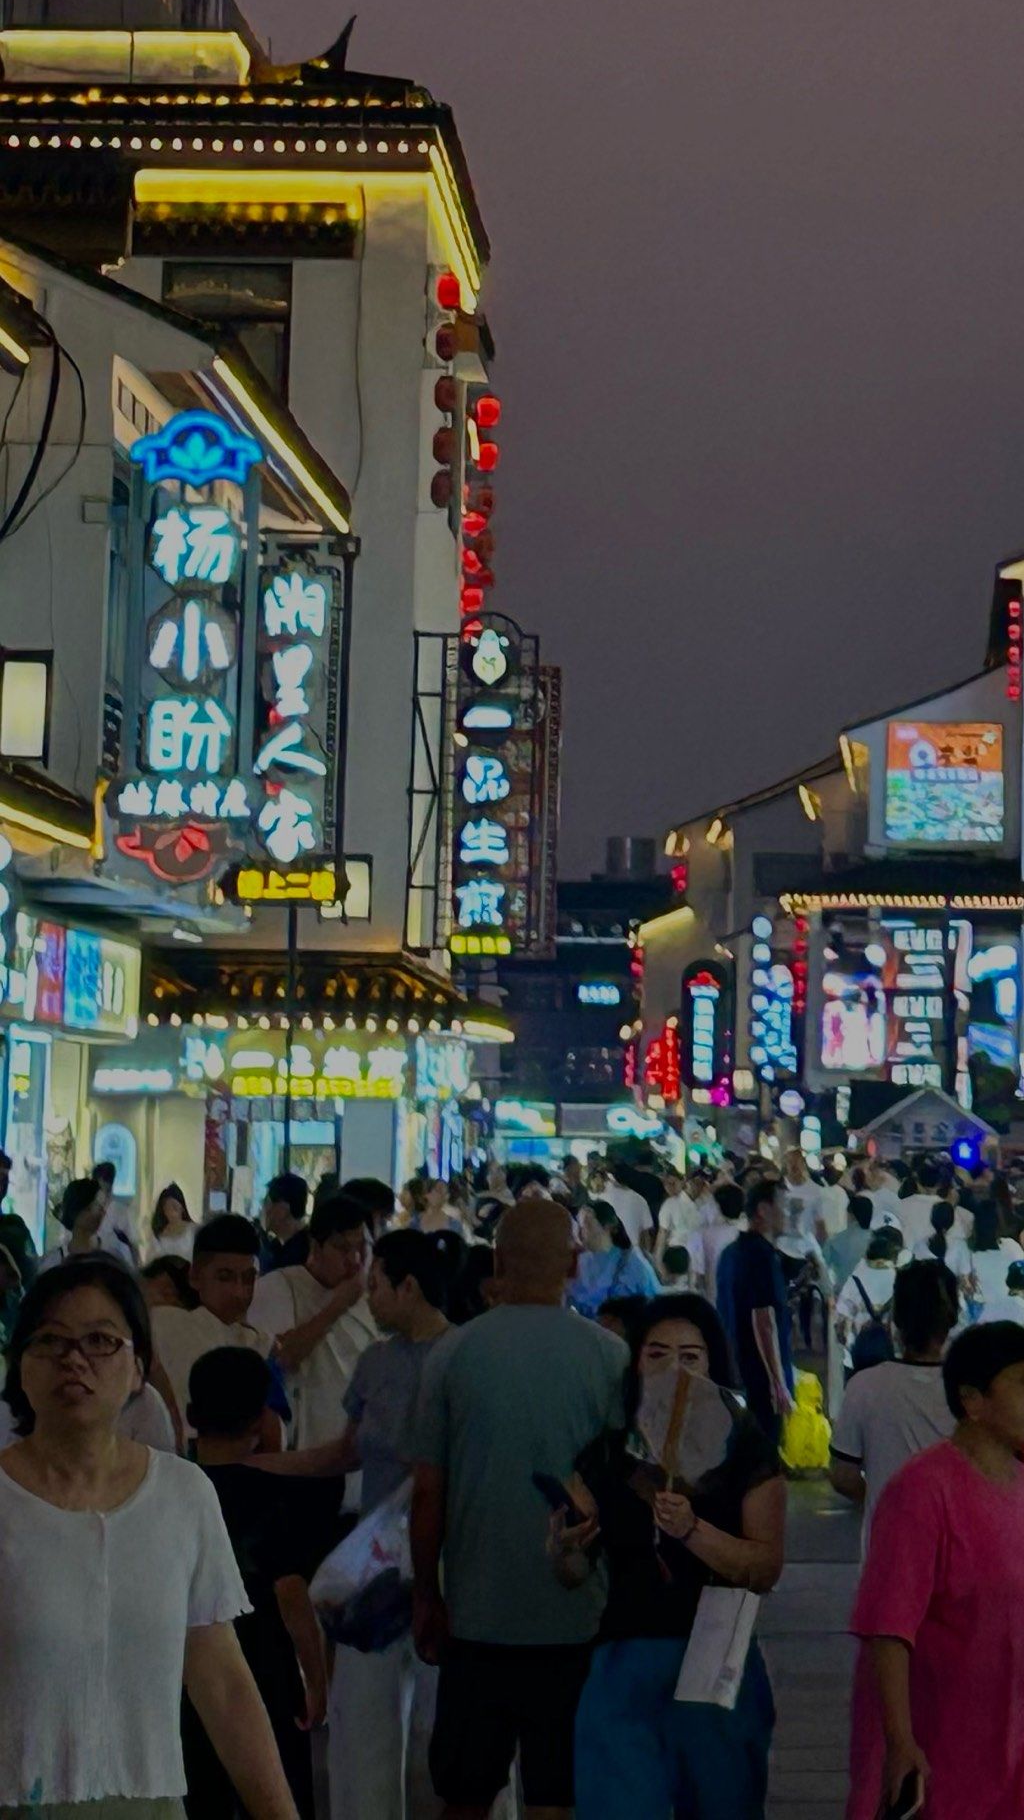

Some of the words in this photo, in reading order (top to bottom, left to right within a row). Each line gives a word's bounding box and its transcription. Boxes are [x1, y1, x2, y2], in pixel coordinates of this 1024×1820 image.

[149, 508, 236, 774] 杨小盼
[455, 705, 513, 928] 一品生煎
